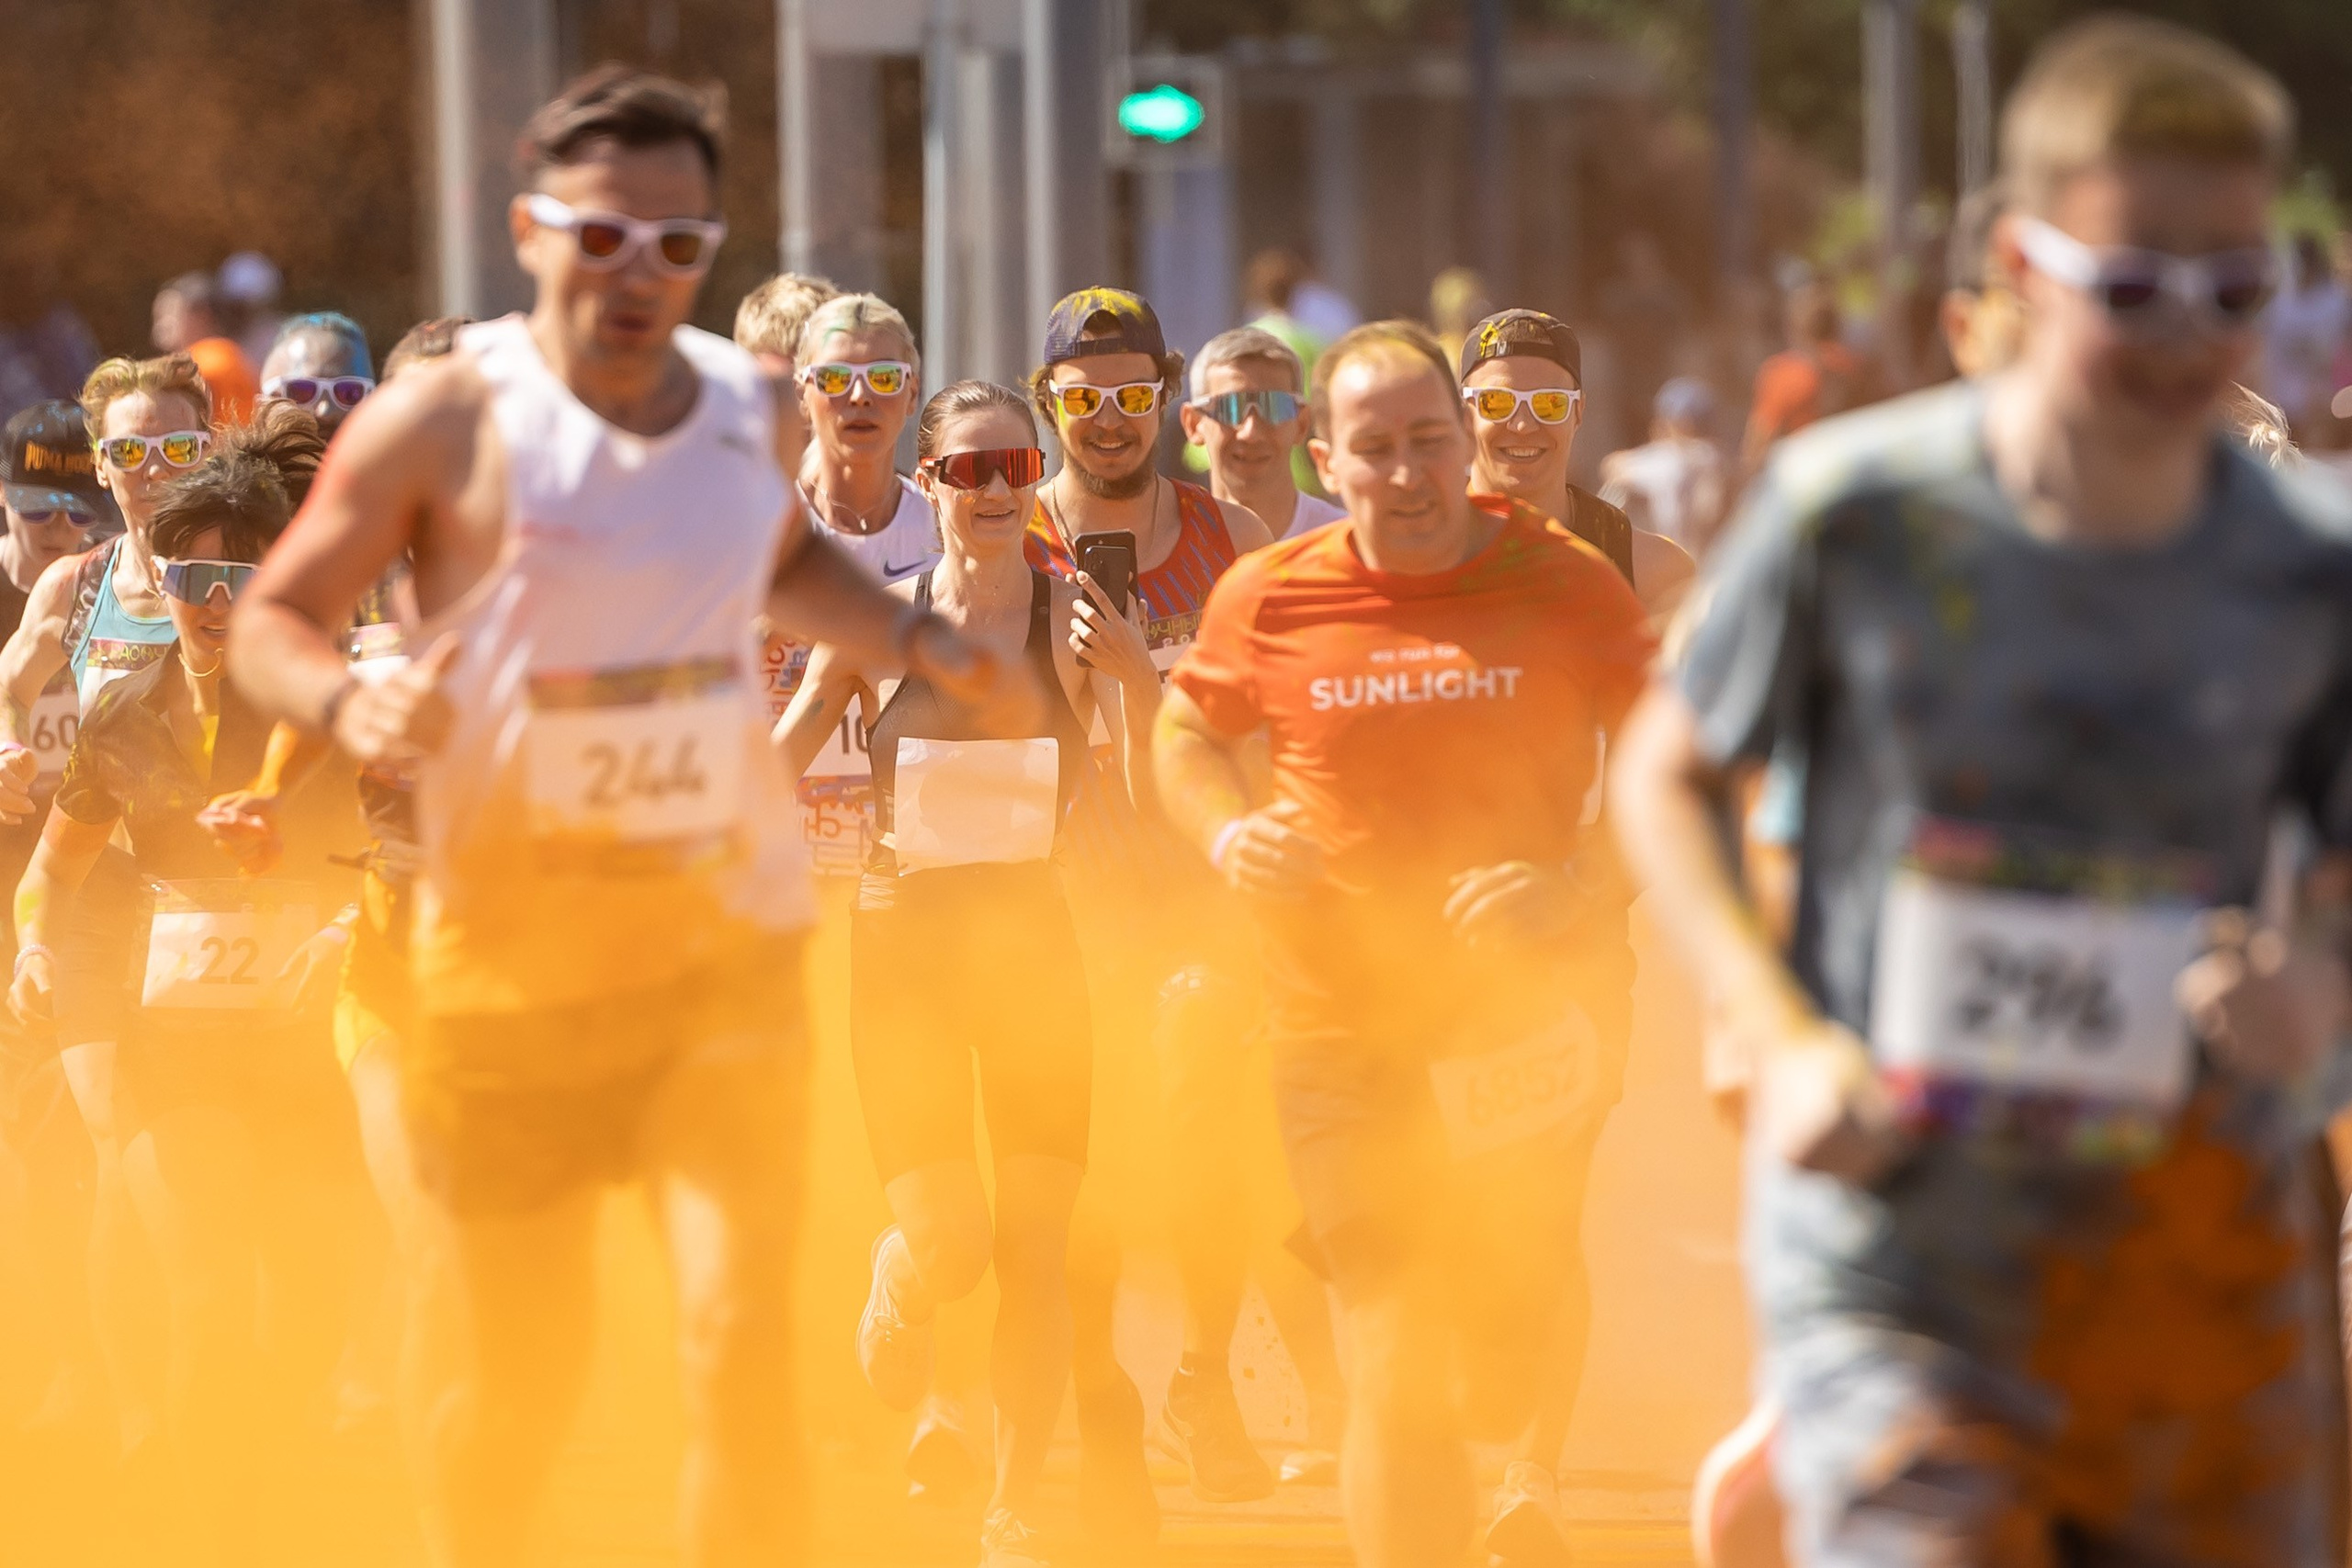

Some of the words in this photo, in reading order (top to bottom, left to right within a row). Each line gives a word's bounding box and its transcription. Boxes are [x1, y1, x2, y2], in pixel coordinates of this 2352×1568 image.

[1309, 666, 1523, 711] SUNLIGHT
[579, 735, 707, 808] 244
[198, 935, 260, 985] 22
